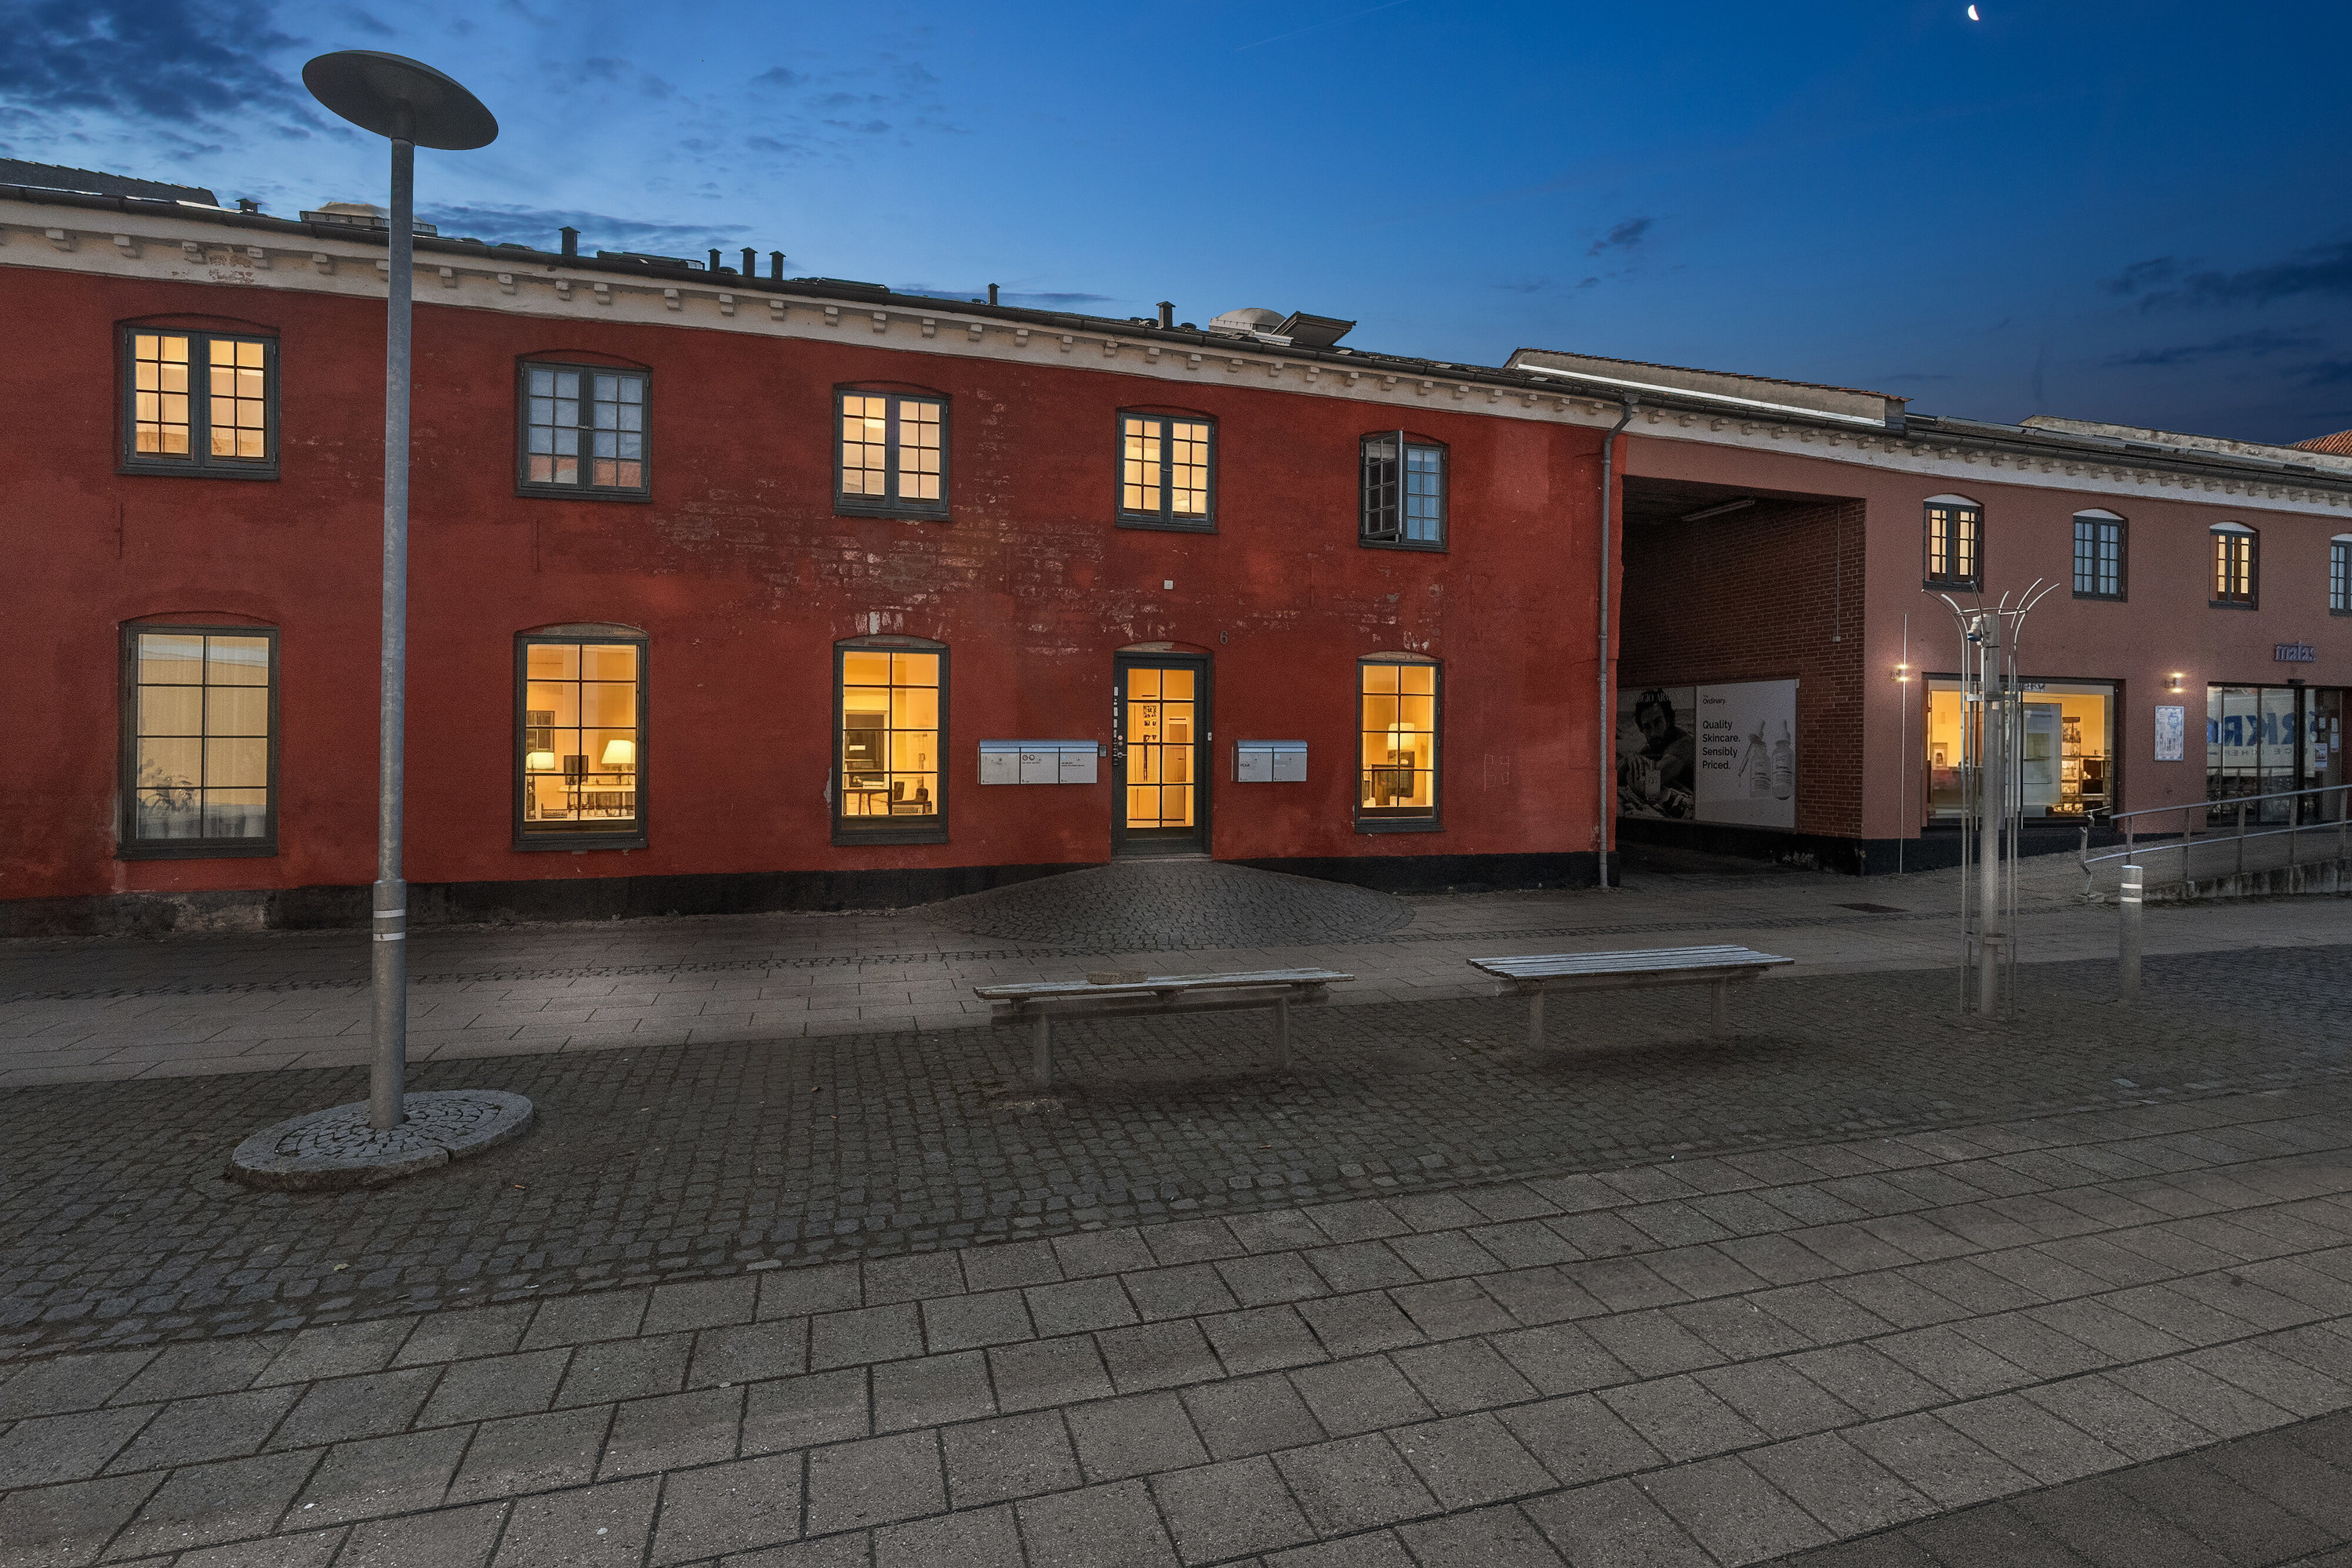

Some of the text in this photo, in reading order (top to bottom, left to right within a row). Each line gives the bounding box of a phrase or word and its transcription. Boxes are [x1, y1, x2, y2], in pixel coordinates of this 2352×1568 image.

[1702, 720, 1733, 731] Quality
[1702, 733, 1740, 742] Skincare.
[1702, 746, 1738, 758] Sensibly
[1702, 760, 1731, 769] Priced.
